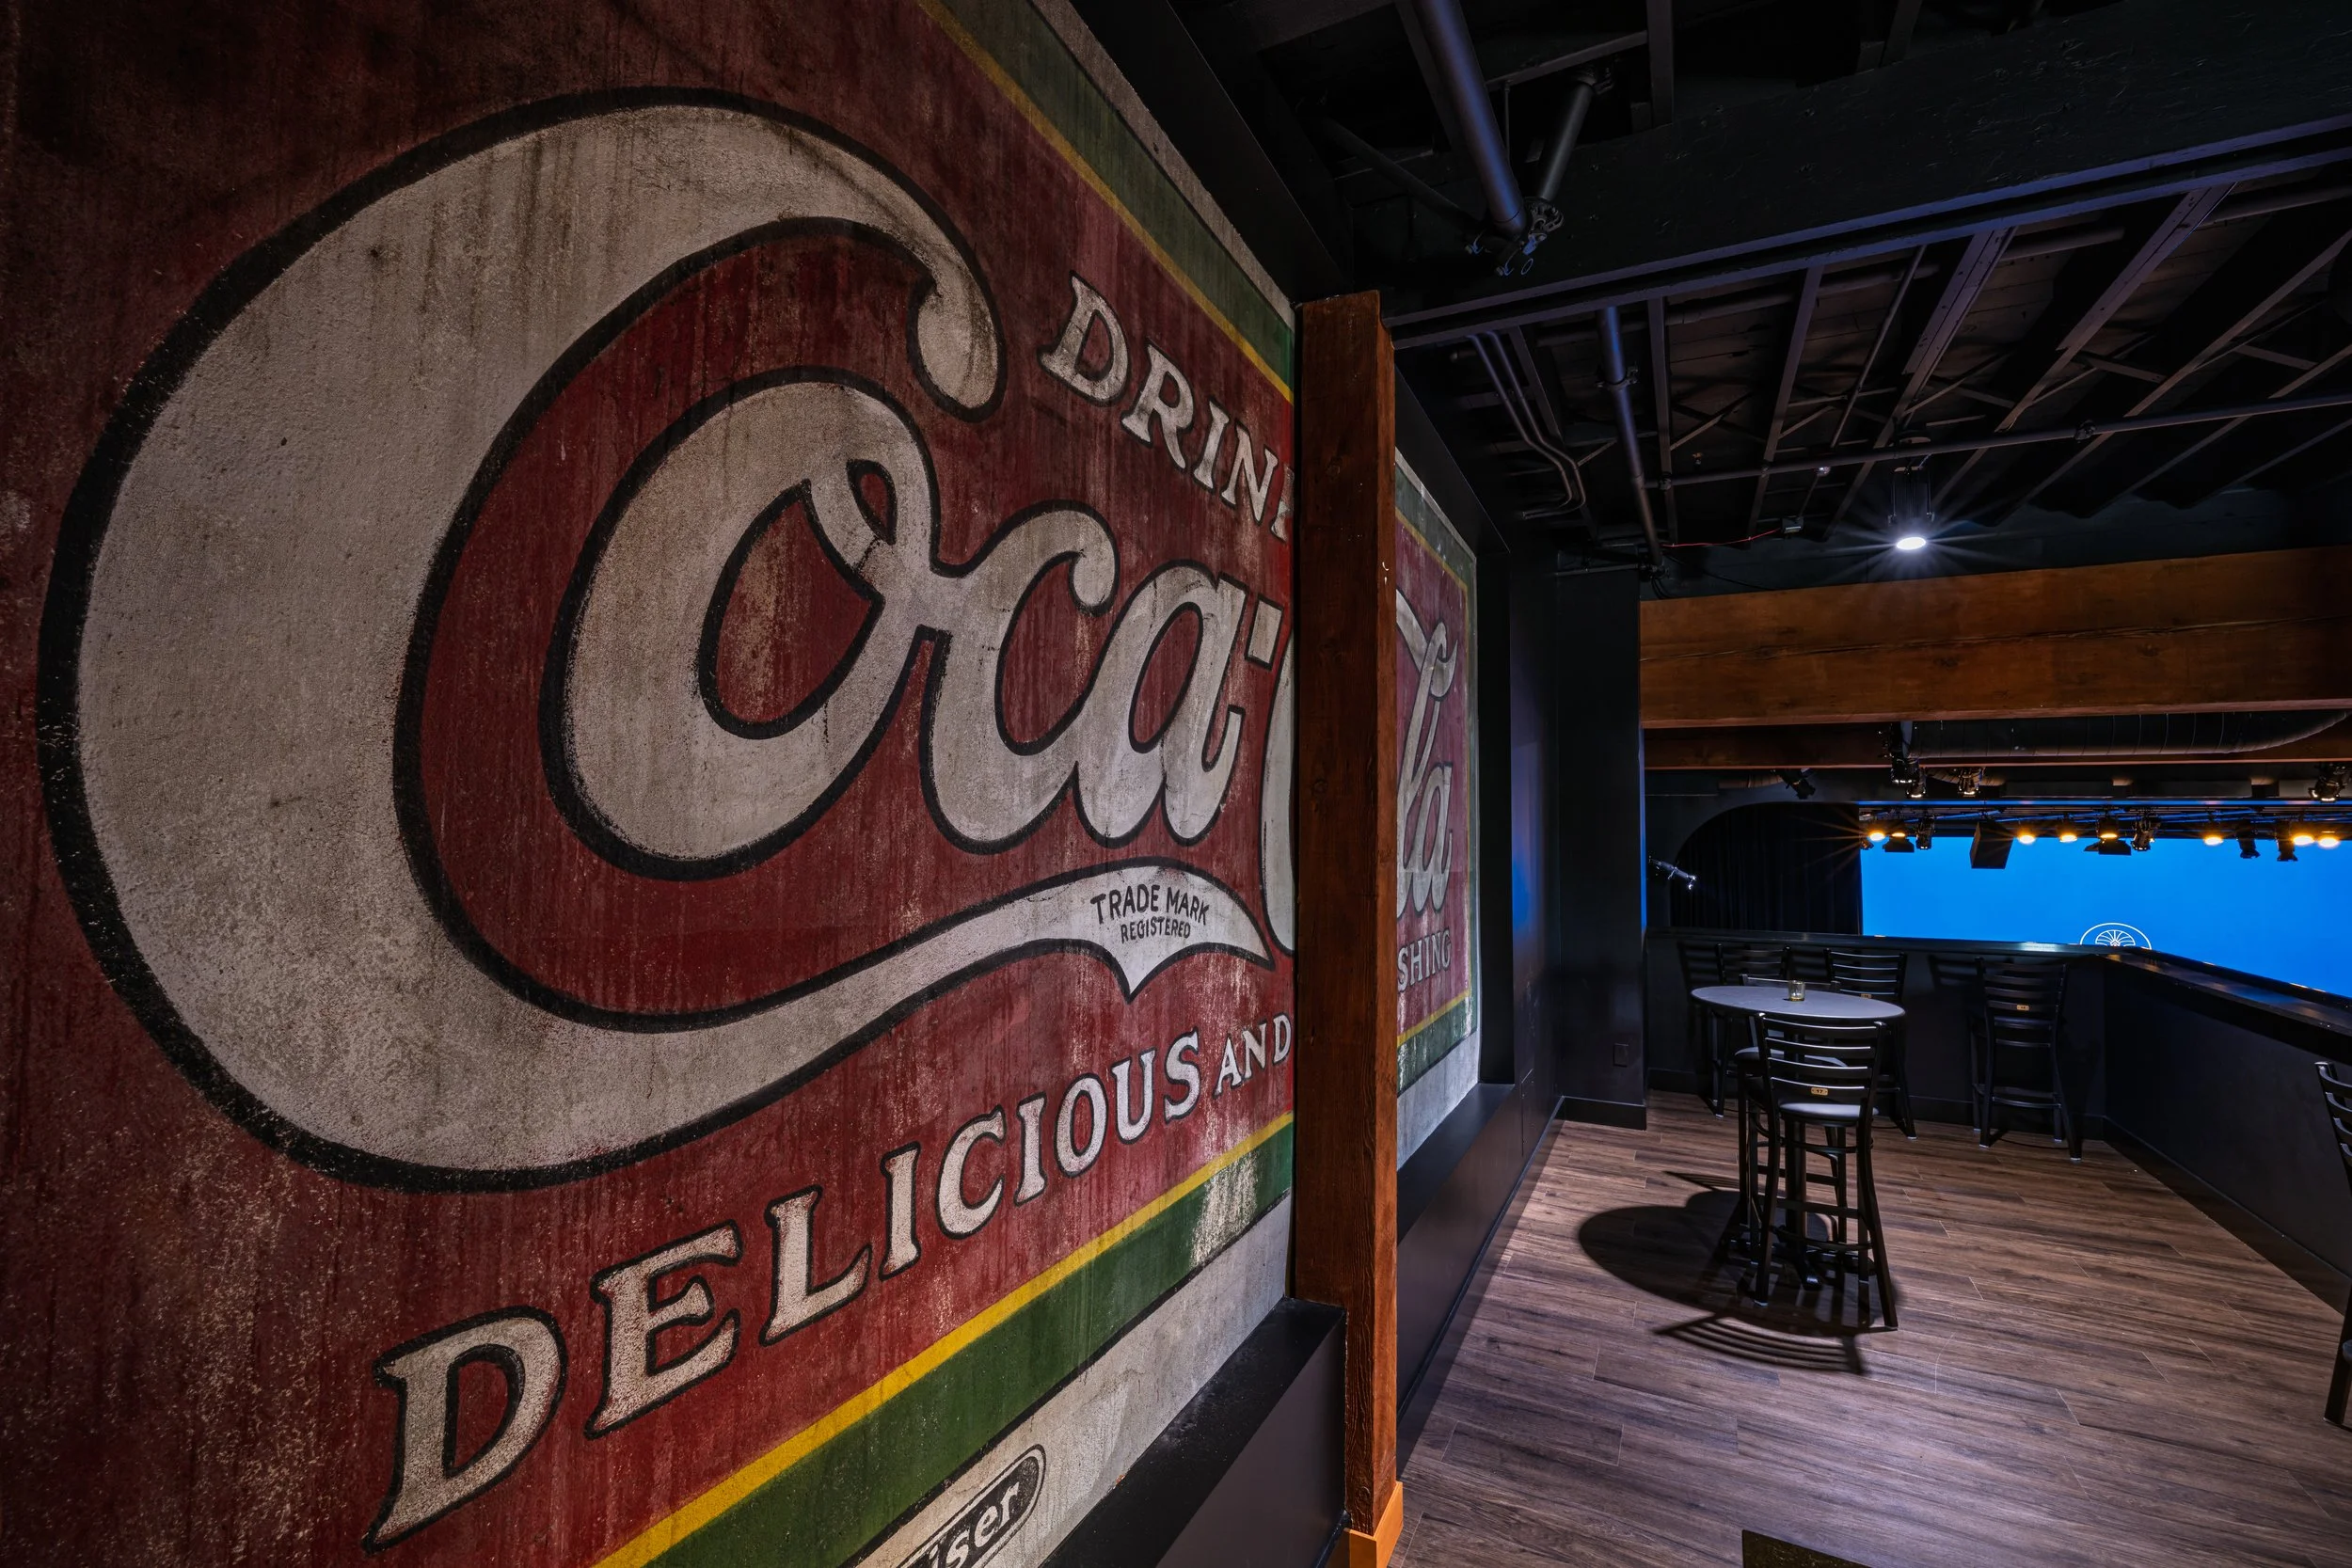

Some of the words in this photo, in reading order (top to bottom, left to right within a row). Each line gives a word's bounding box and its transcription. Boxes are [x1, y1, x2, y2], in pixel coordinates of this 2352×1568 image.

[1089, 883, 1161, 925] TRADE
[1166, 886, 1210, 927] MARK
[1120, 915, 1192, 944] REGISTERED
[361, 1027, 1201, 1554] DELICIOUS
[1214, 1011, 1293, 1099] AND
[1396, 927, 1452, 993] SHING
